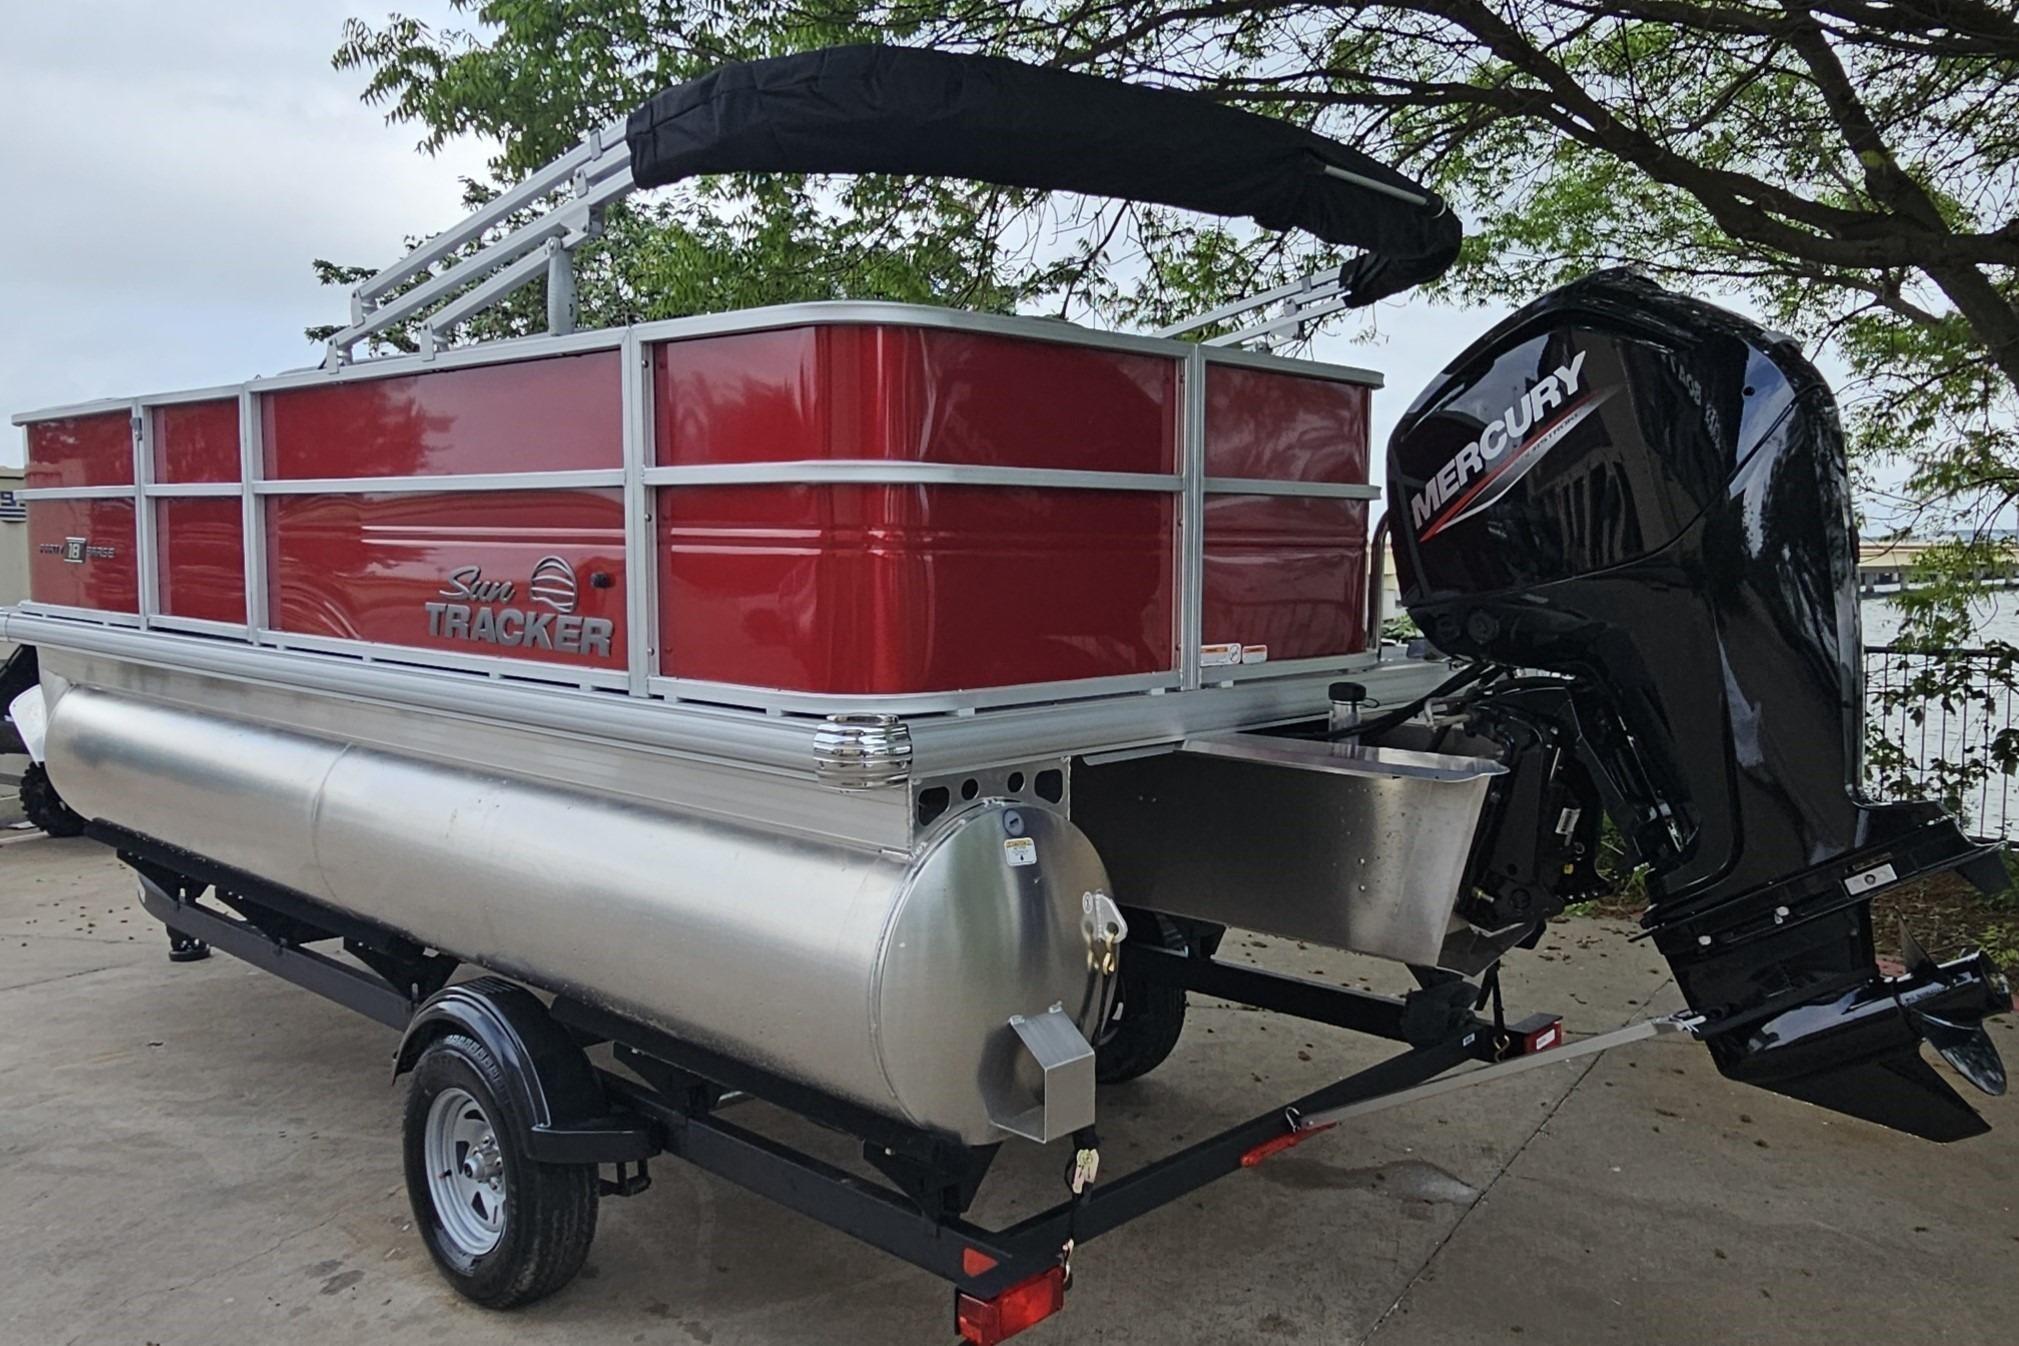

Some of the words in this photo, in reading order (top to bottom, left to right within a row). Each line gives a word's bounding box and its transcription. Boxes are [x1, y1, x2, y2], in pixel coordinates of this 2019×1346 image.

[1411, 350, 1586, 530] MERCURY
[68, 543, 80, 559] 18
[439, 565, 515, 604] Sun
[425, 602, 613, 657] TRACKER
